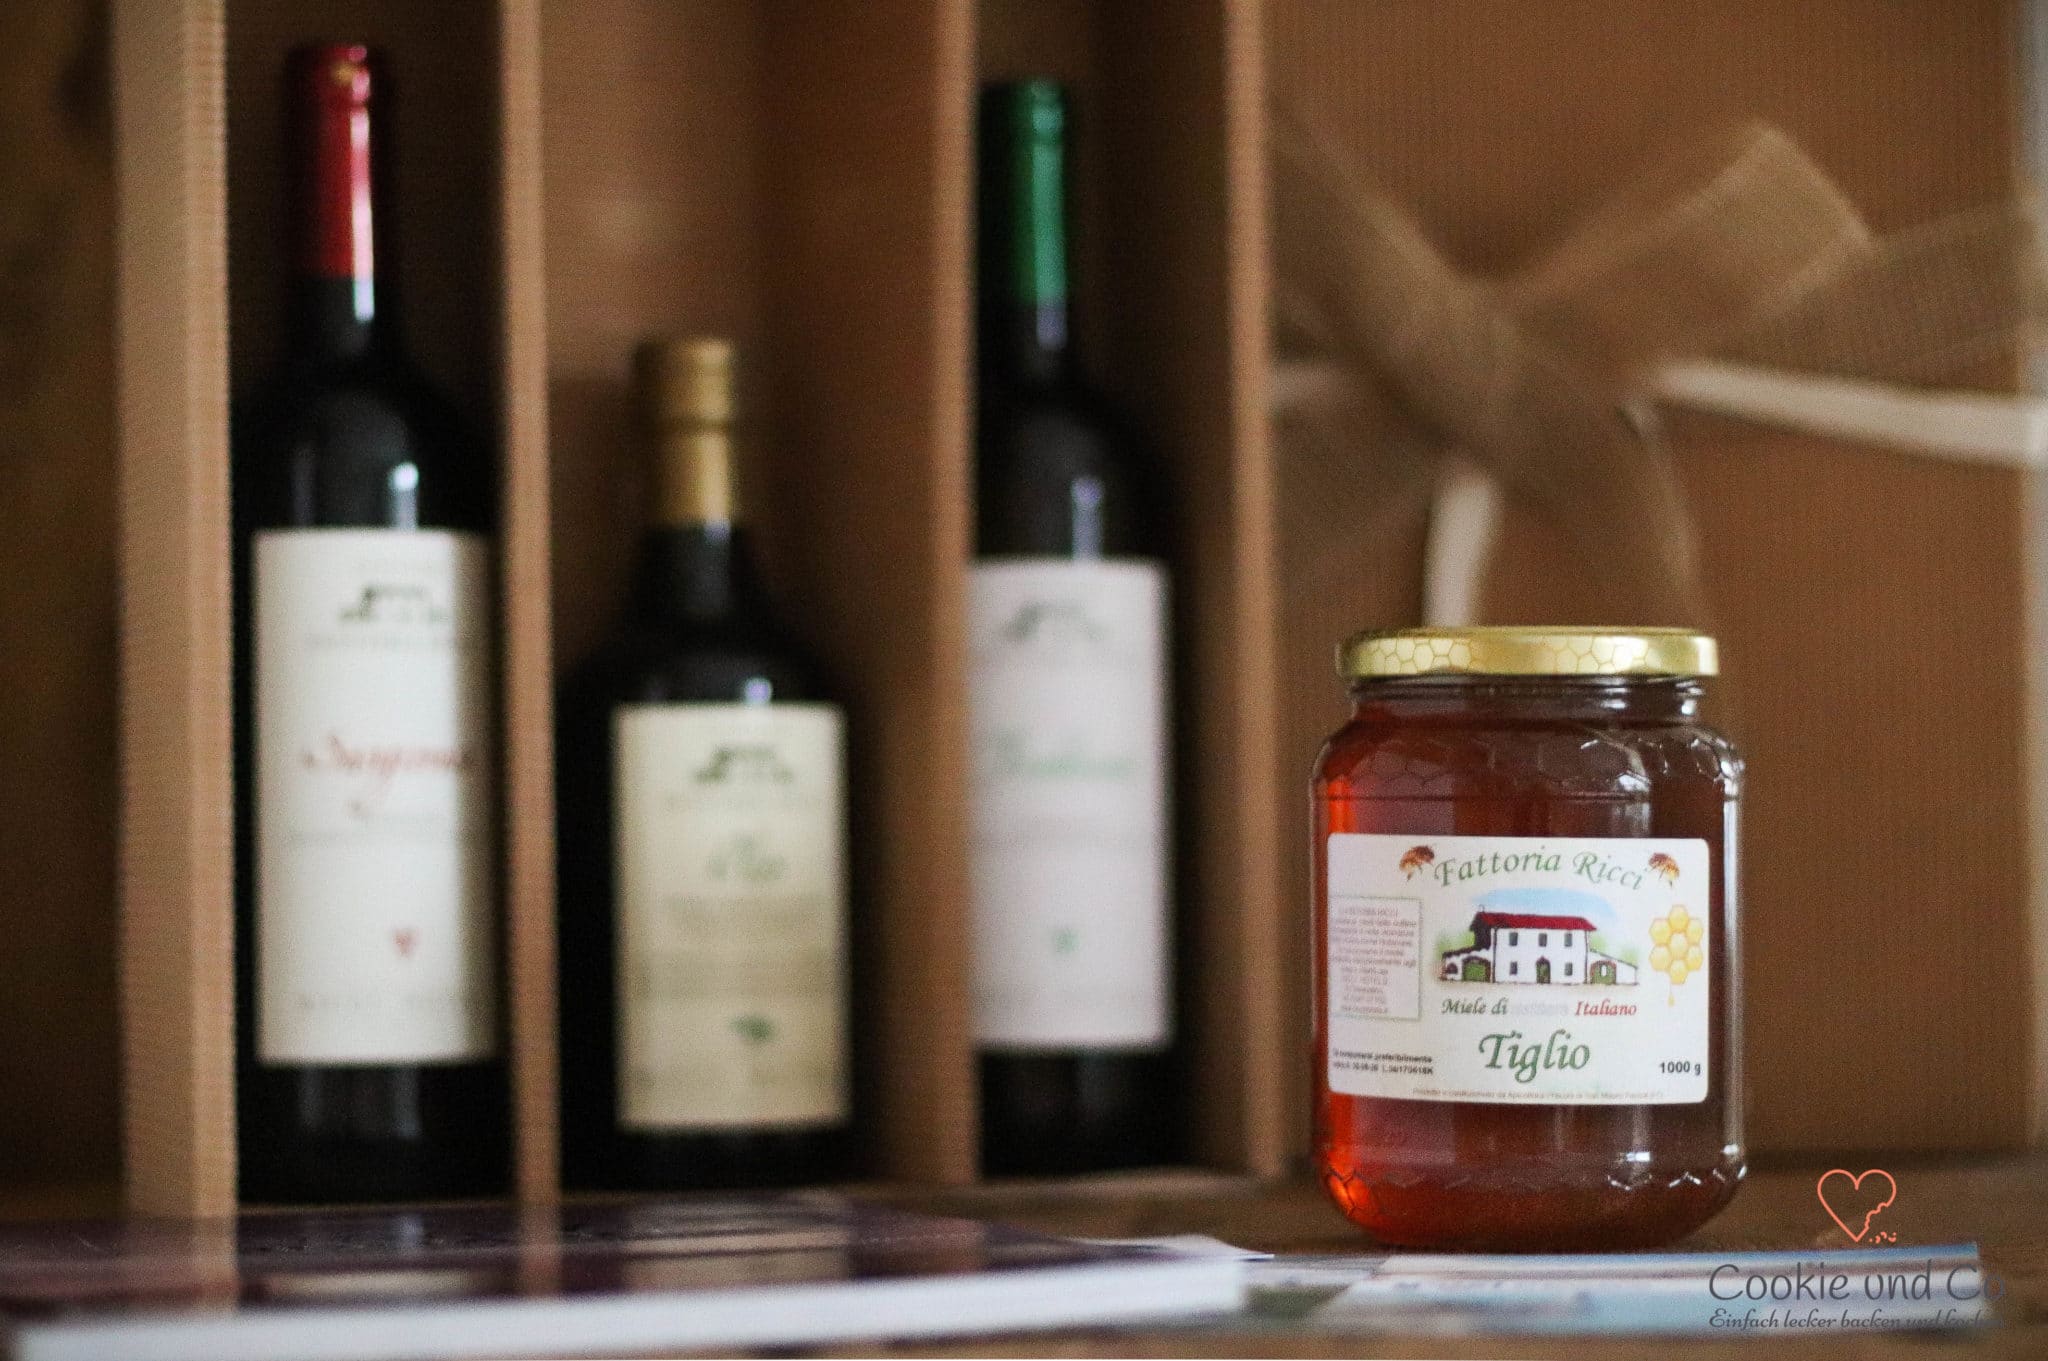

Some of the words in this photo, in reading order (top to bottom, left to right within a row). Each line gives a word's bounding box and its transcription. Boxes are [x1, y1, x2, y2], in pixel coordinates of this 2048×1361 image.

[1434, 845, 1562, 888] Fattoria
[1572, 850, 1649, 891] Ricci
[1441, 998, 1487, 1015] Miele
[1491, 996, 1509, 1015] di
[1574, 998, 1637, 1016] Italiano
[1478, 1028, 1591, 1083] Tiglio
[1658, 1061, 1691, 1074] 1000
[1694, 1064, 1702, 1076] g
